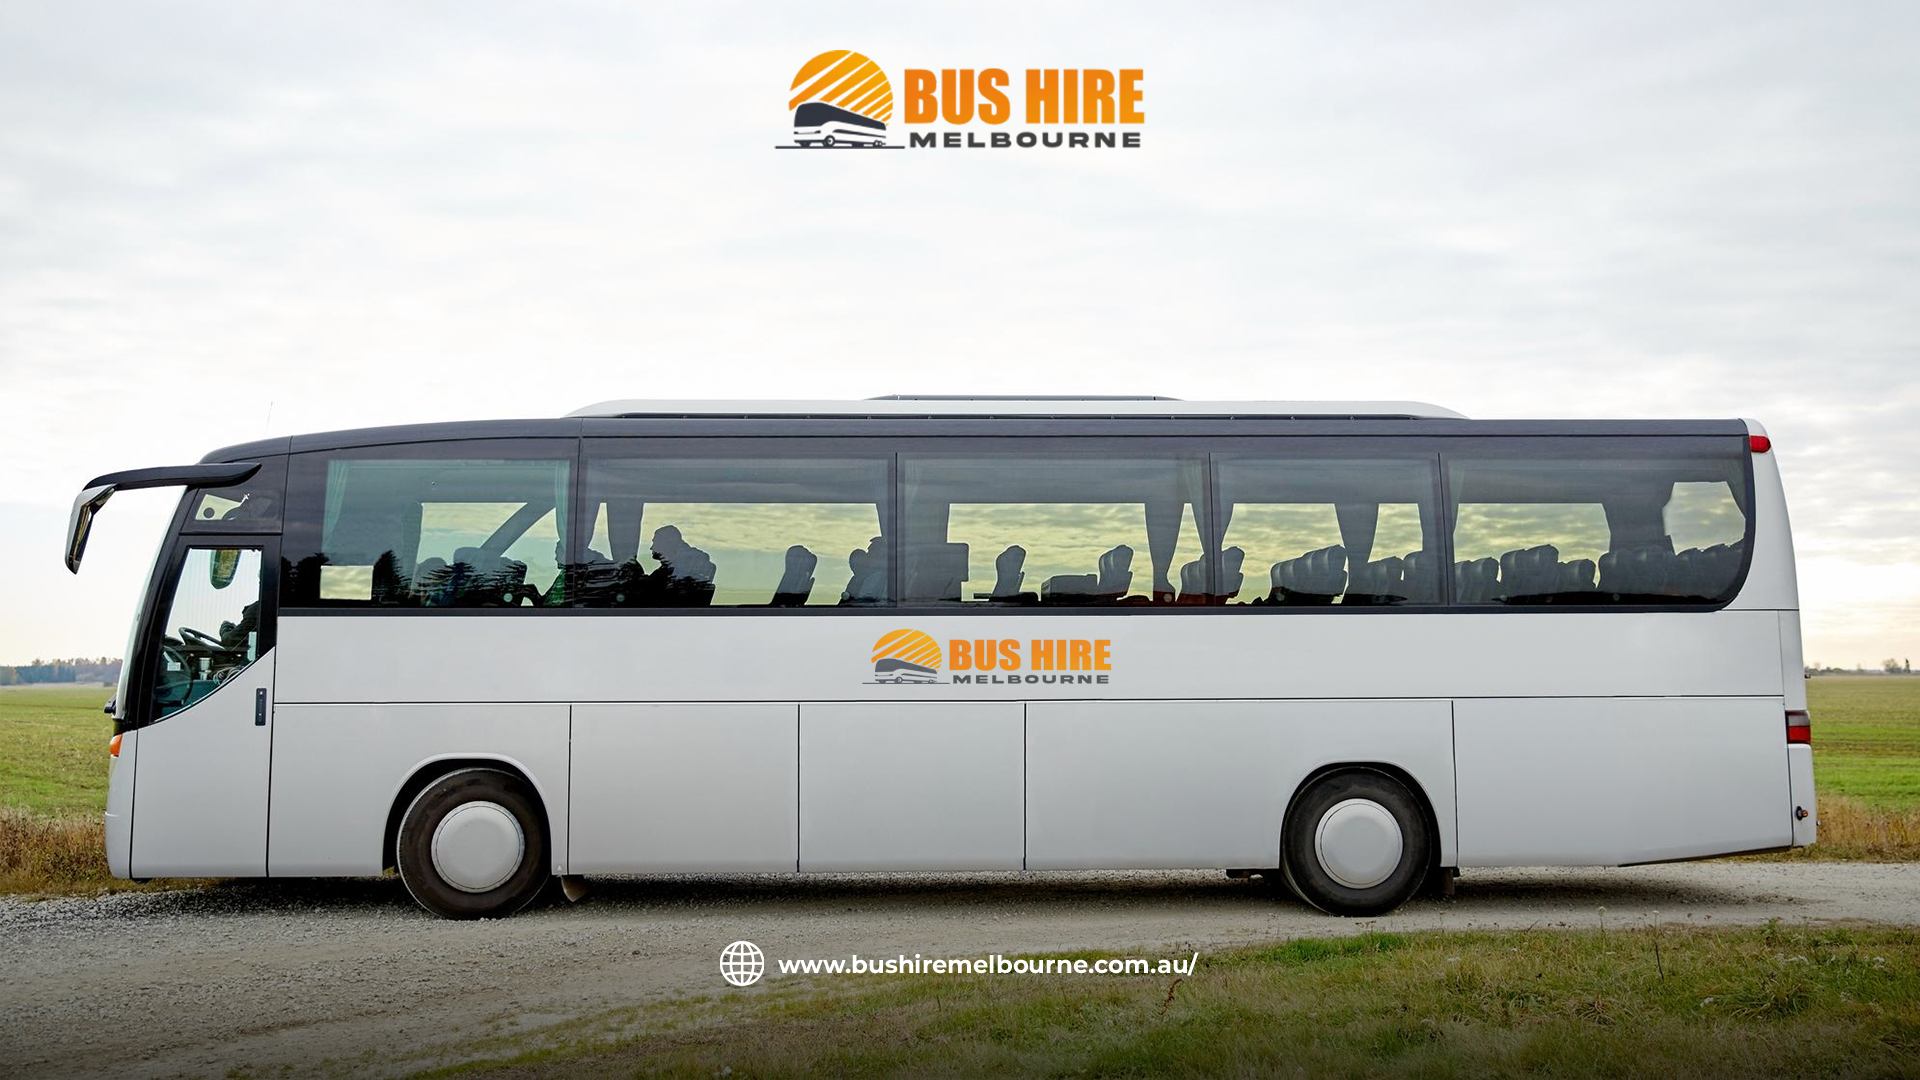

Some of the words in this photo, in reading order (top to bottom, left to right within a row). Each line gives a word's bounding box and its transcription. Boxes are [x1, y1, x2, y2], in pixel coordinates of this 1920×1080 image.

[949, 639, 1021, 671] BUS
[1031, 639, 1111, 671] HIRE
[953, 675, 1109, 684] MELBOURNE
